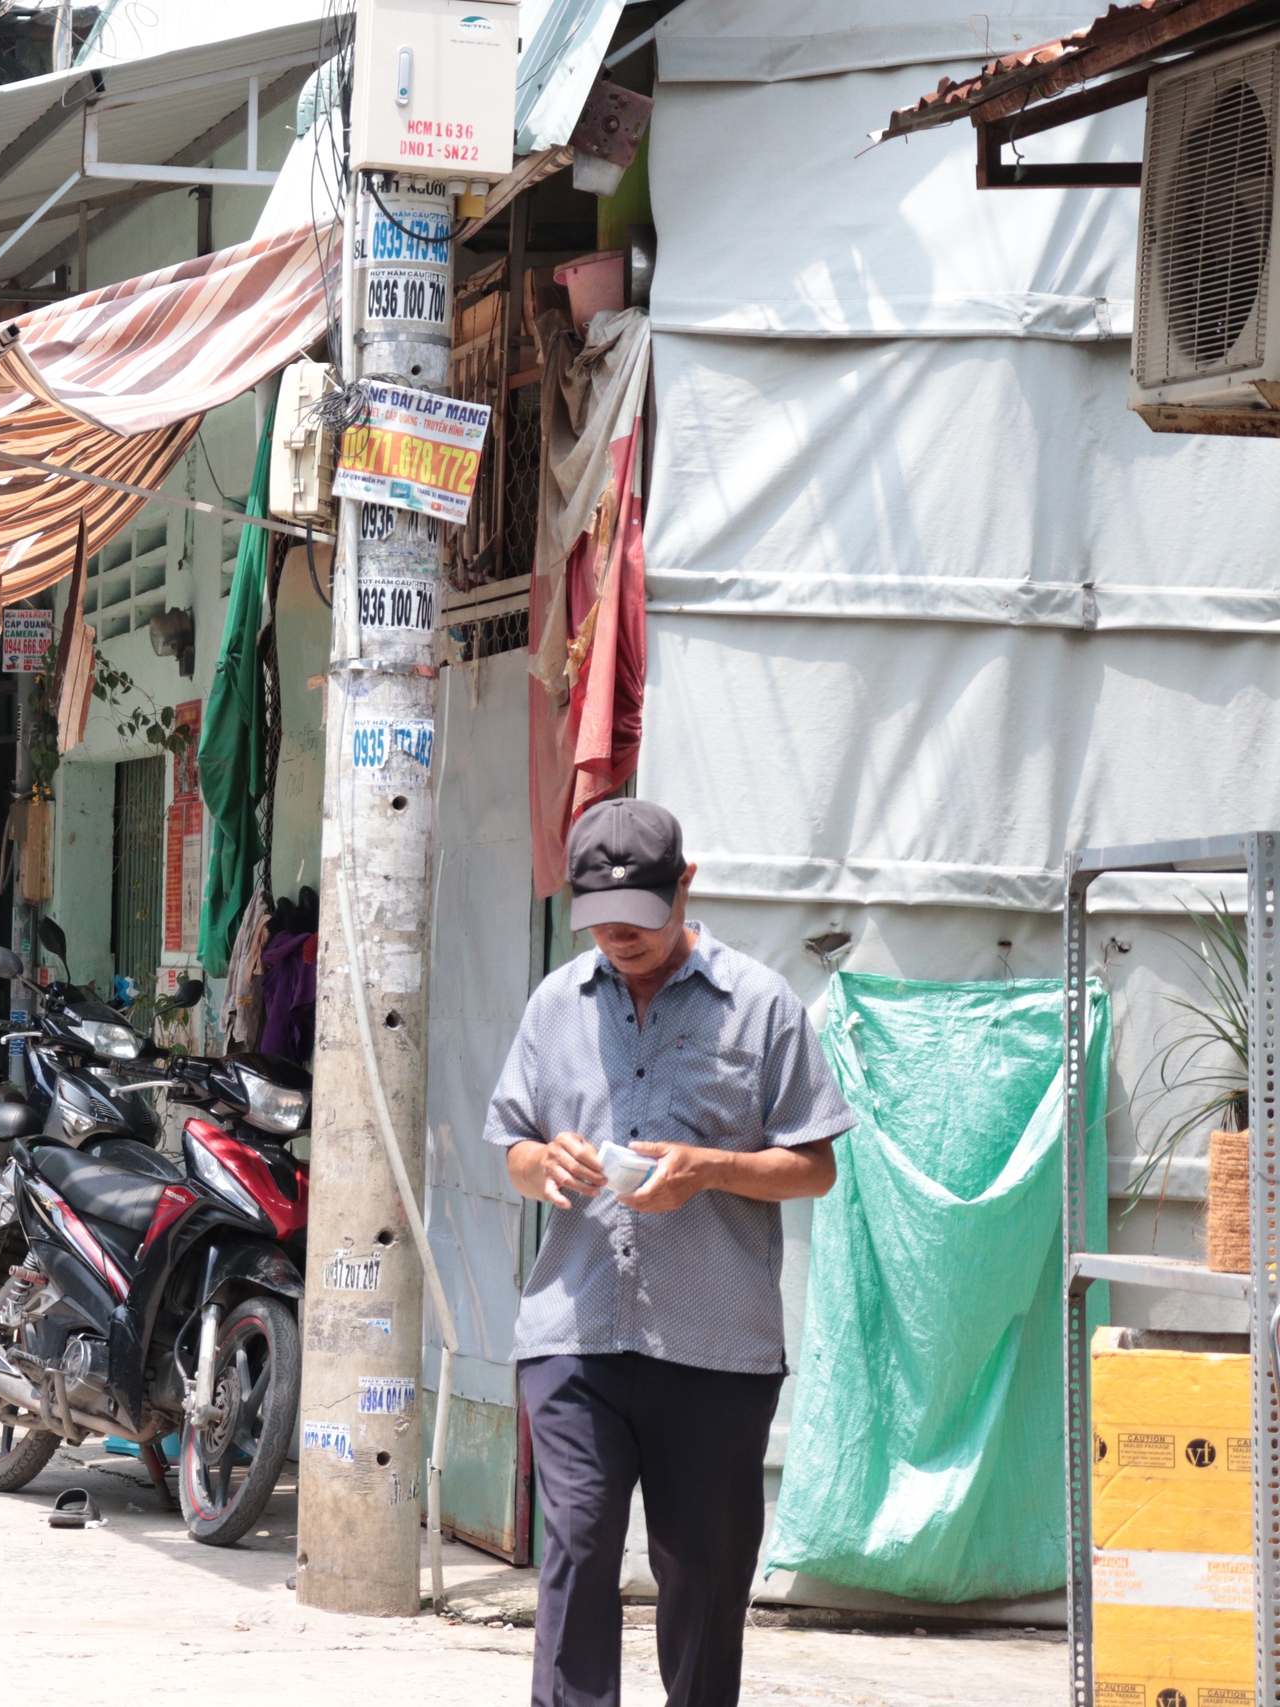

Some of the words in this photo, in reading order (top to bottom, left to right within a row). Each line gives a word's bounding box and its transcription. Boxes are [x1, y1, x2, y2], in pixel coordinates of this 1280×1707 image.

[399, 139, 479, 161] DN01-SN22
[368, 279, 446, 323] 0936.100.700
[445, 403, 489, 427] MẠNG
[341, 426, 479, 495] 0971.678.772
[23, 619, 47, 629] QUAN
[4, 629, 39, 638] CAMERA
[165, 1188, 186, 1204] HONDA
[1127, 1434, 1166, 1443] CAUTION
[1095, 1579, 1111, 1588] SEAL
[1113, 1580, 1143, 1590] BEFORE
[1097, 1683, 1136, 1692] CAUTION
[1207, 1689, 1246, 1699] CAUTION
